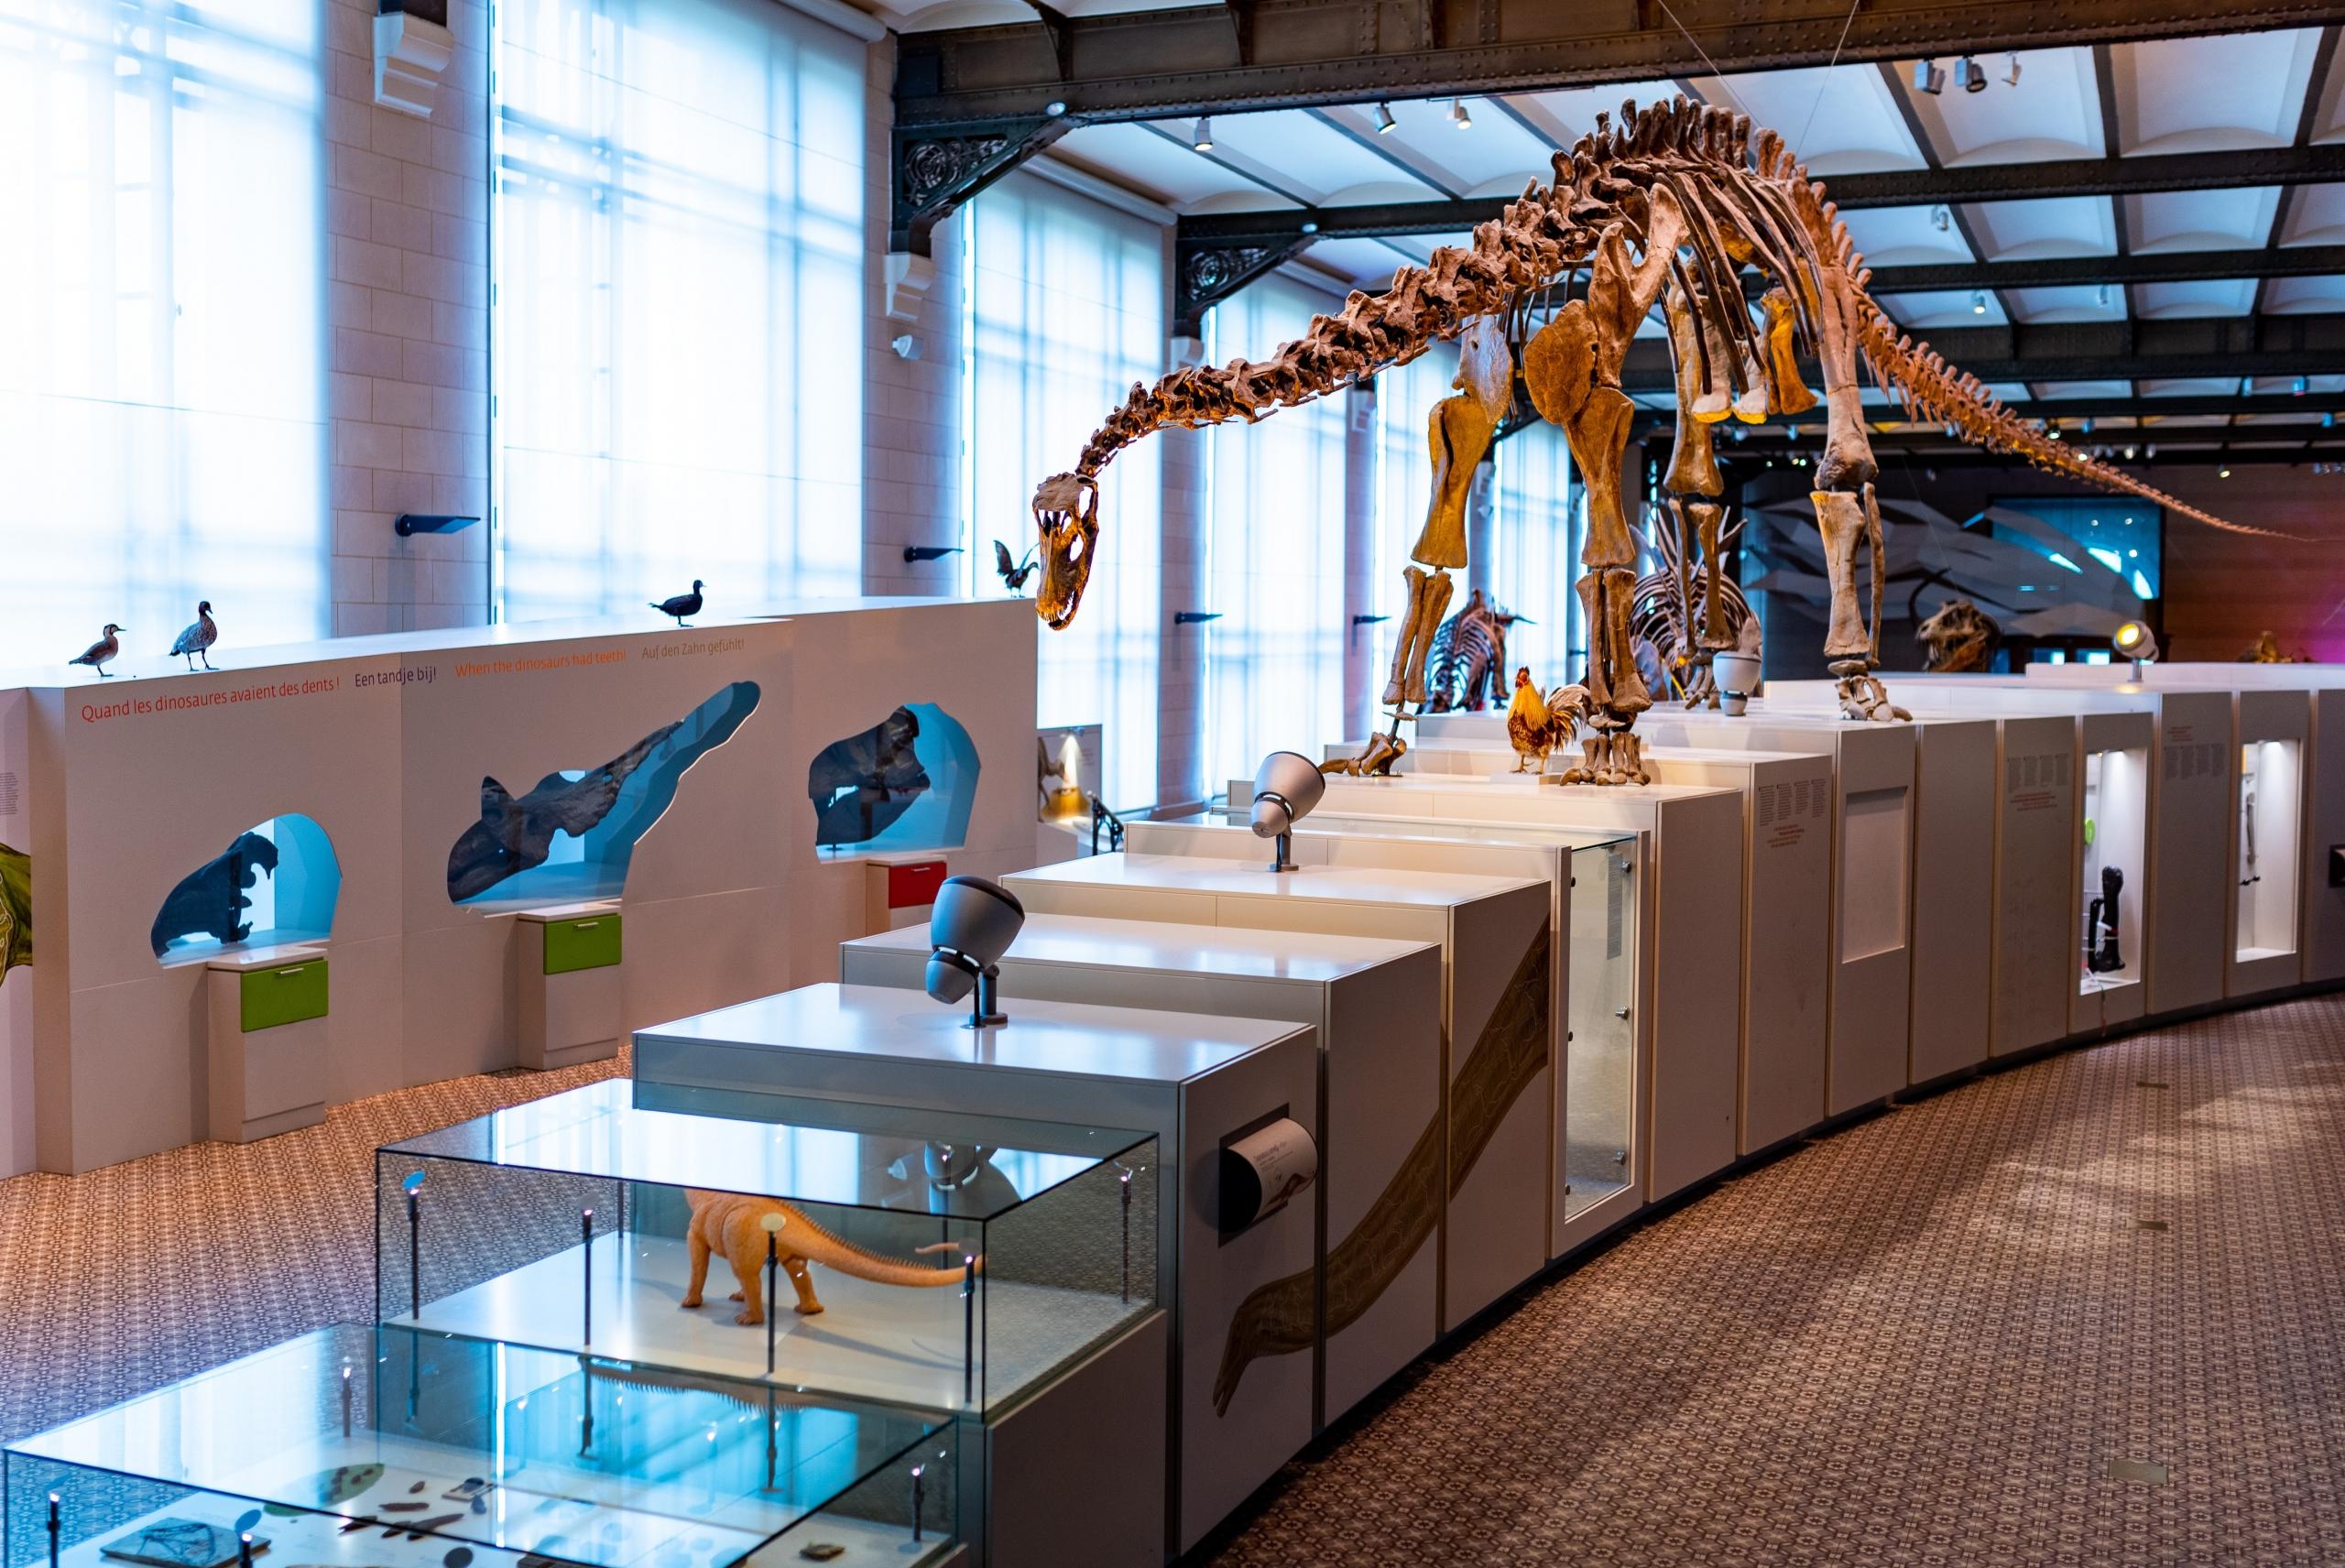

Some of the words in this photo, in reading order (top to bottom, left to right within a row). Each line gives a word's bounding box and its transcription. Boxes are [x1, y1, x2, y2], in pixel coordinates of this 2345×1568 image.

[642, 645, 660, 659] Auf
[660, 642, 680, 657] den
[682, 641, 706, 655] Zahn
[455, 660, 491, 678] When
[493, 659, 512, 674] the
[515, 655, 571, 672] dinosaurs
[572, 651, 593, 666] had
[354, 673, 375, 688] Een
[377, 668, 414, 685] tandje
[417, 666, 437, 683] bij!
[82, 701, 130, 723] Quand
[134, 698, 152, 714] les
[155, 688, 227, 712] dinosaures
[230, 683, 276, 704] avaient
[278, 681, 300, 697] des
